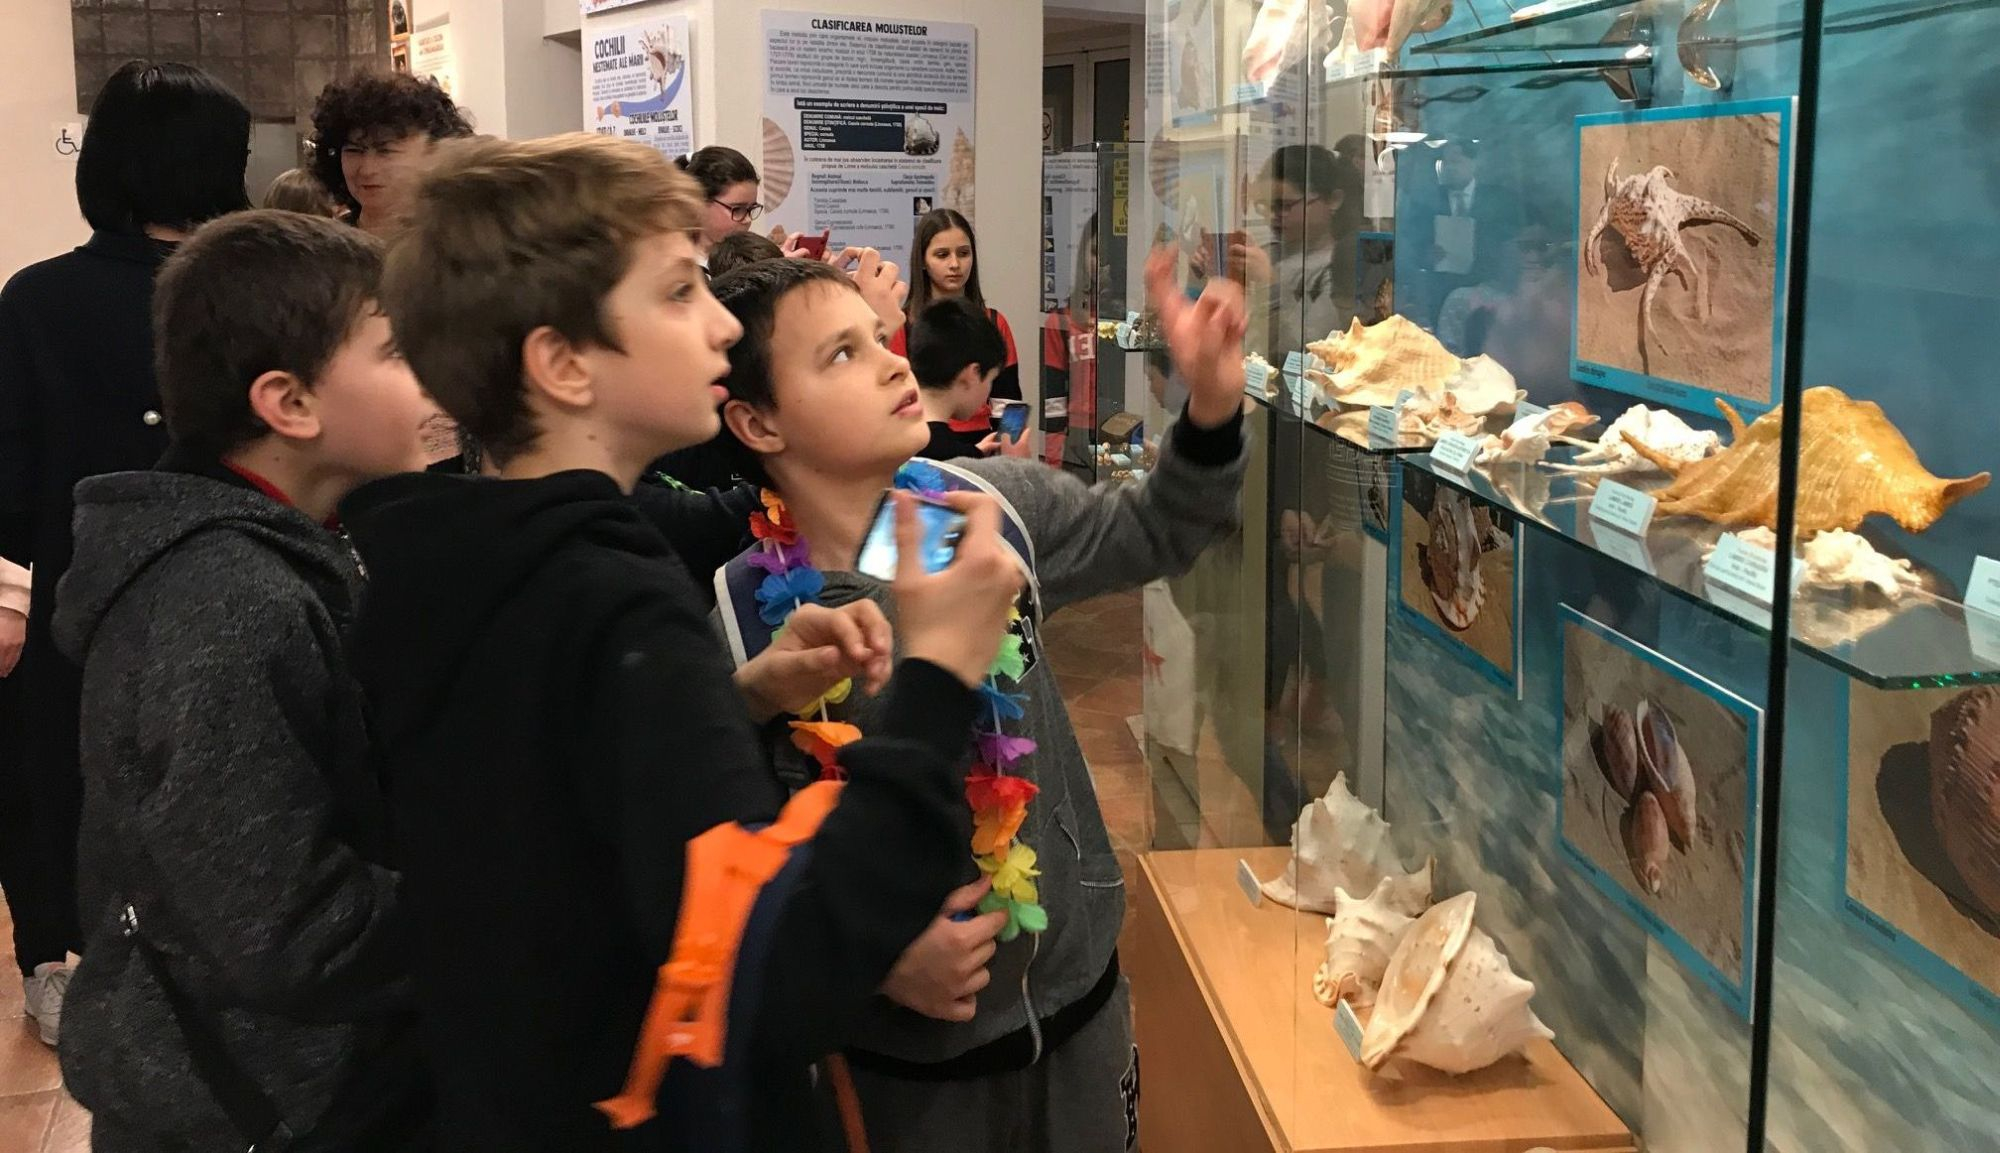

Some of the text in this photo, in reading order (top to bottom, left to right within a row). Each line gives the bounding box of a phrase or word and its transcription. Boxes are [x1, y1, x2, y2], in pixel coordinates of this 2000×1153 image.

[811, 19, 928, 36] CLASIFICAREA MOLUSTELOR
[594, 35, 626, 59] COCHILII
[593, 58, 618, 73] NESTEMATE
[619, 56, 628, 69] ALE
